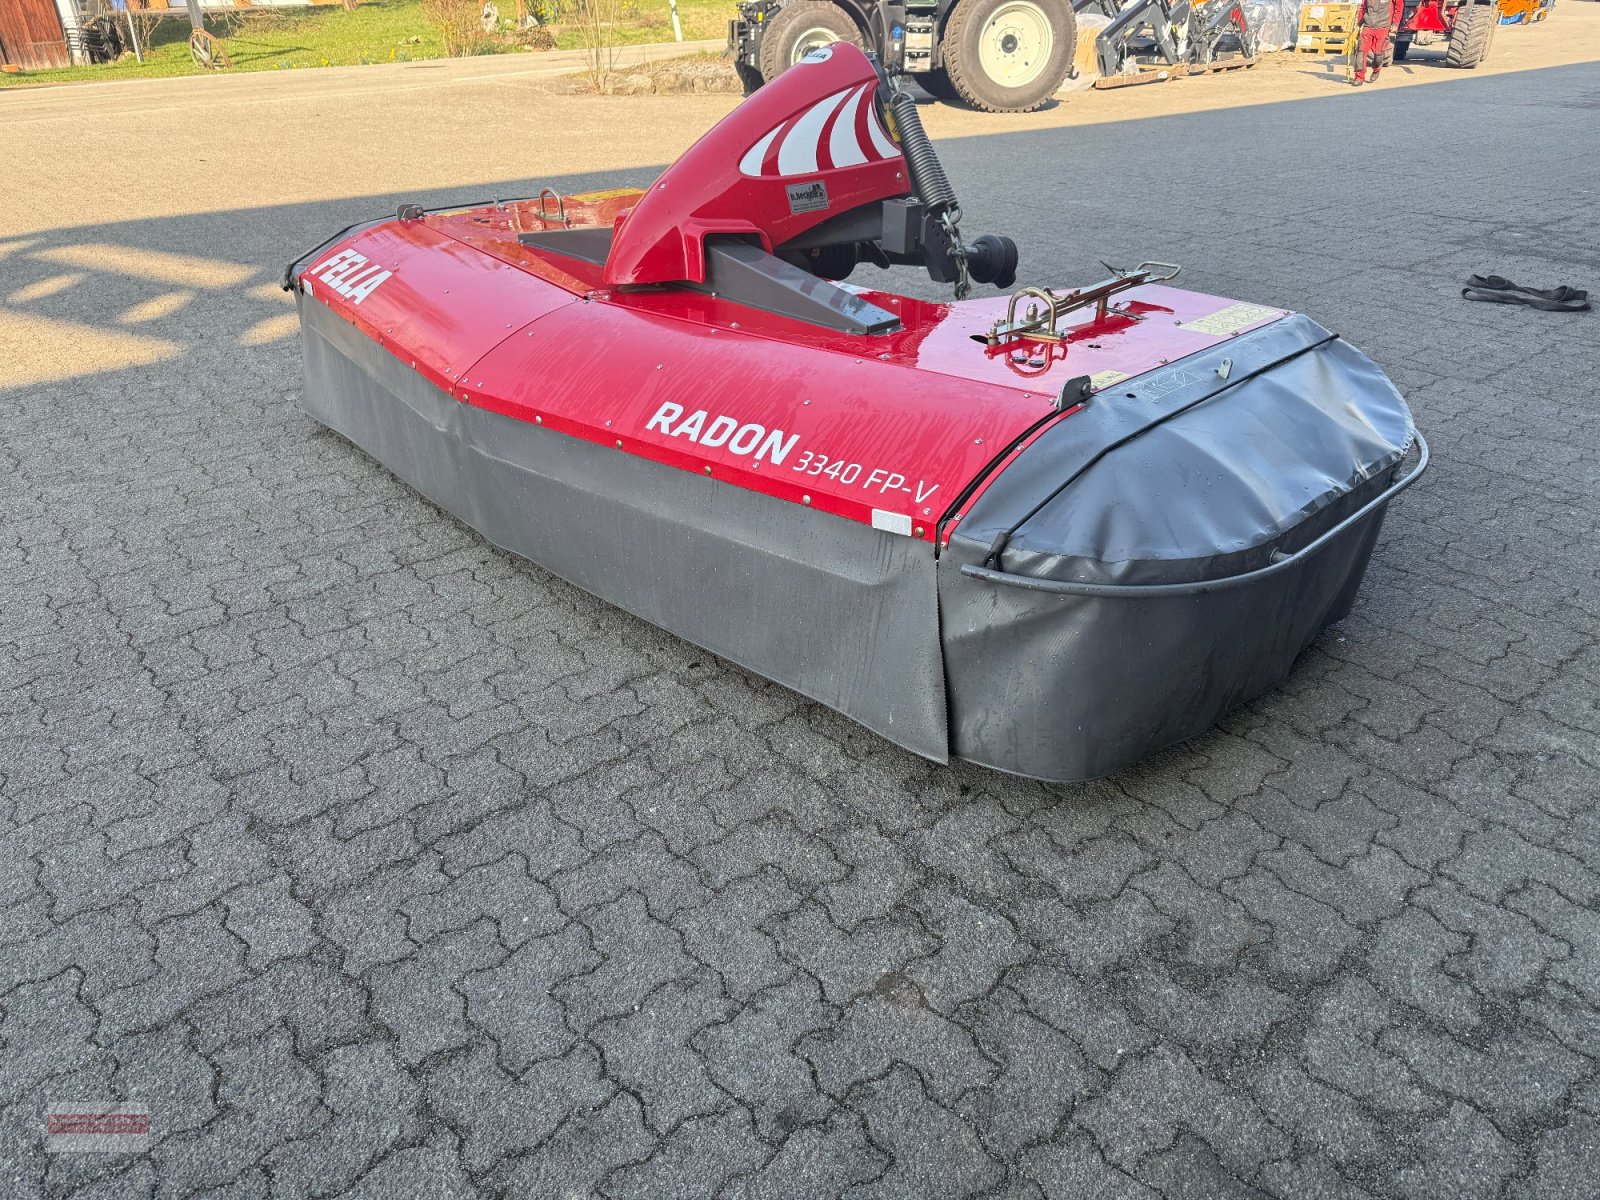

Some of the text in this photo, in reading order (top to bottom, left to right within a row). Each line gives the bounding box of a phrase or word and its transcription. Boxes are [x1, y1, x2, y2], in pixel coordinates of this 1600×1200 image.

[310, 248, 392, 305] FELLA
[645, 401, 939, 504] RADON 3340 FP-V
